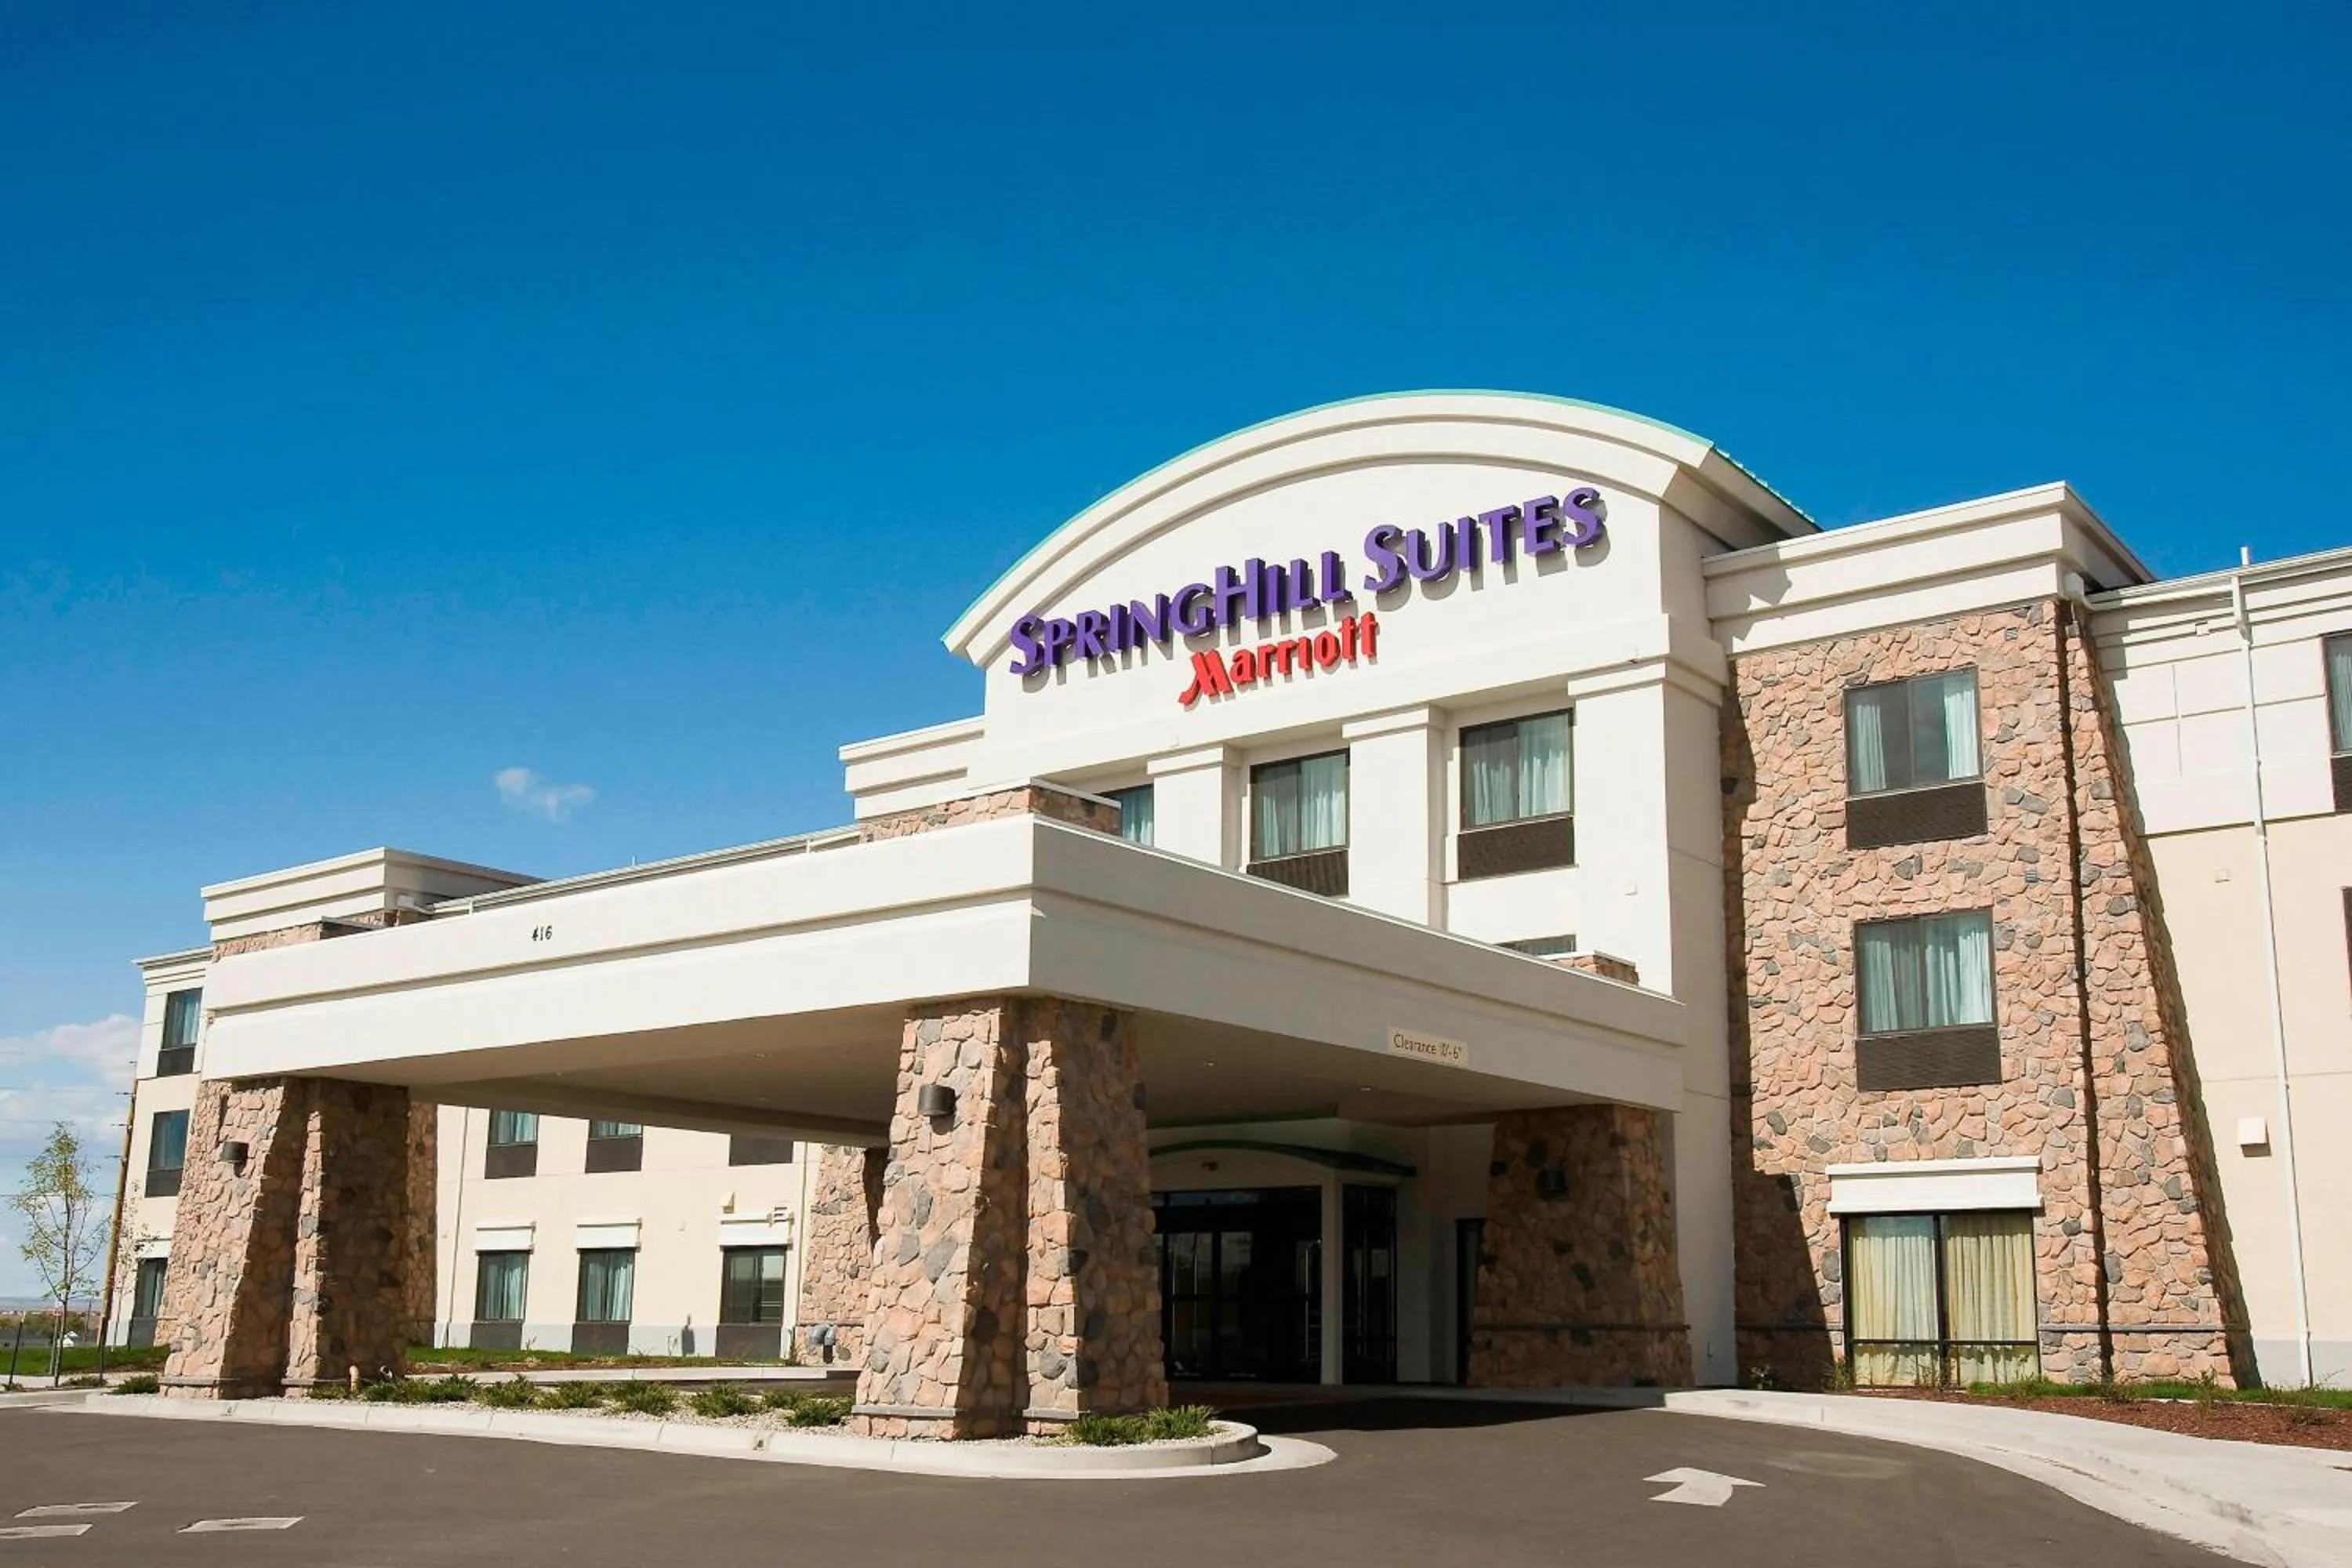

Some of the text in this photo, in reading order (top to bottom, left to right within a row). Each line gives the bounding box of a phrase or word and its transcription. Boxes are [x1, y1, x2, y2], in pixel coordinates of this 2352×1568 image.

[1364, 488, 1603, 594] SUITES
[1178, 612, 1380, 706] Marriott
[532, 924, 553, 942] 416
[1393, 1033, 1436, 1054] Clearance
